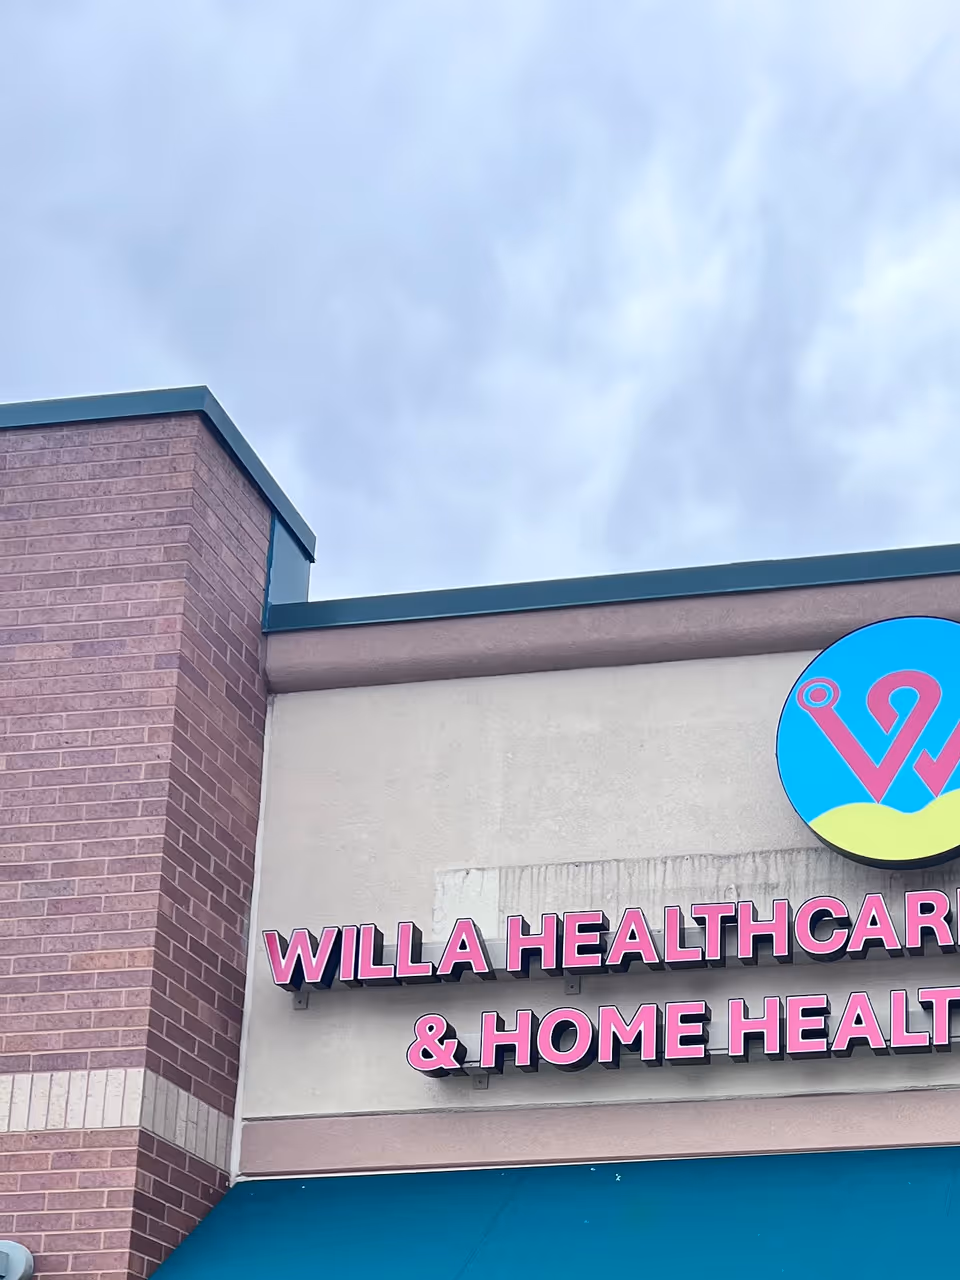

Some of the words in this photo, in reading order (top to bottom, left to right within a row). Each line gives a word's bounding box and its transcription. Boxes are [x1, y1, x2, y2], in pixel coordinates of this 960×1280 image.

[262, 918, 490, 986] WILLA
[406, 1013, 462, 1073] &
[479, 1001, 707, 1068] HOME
